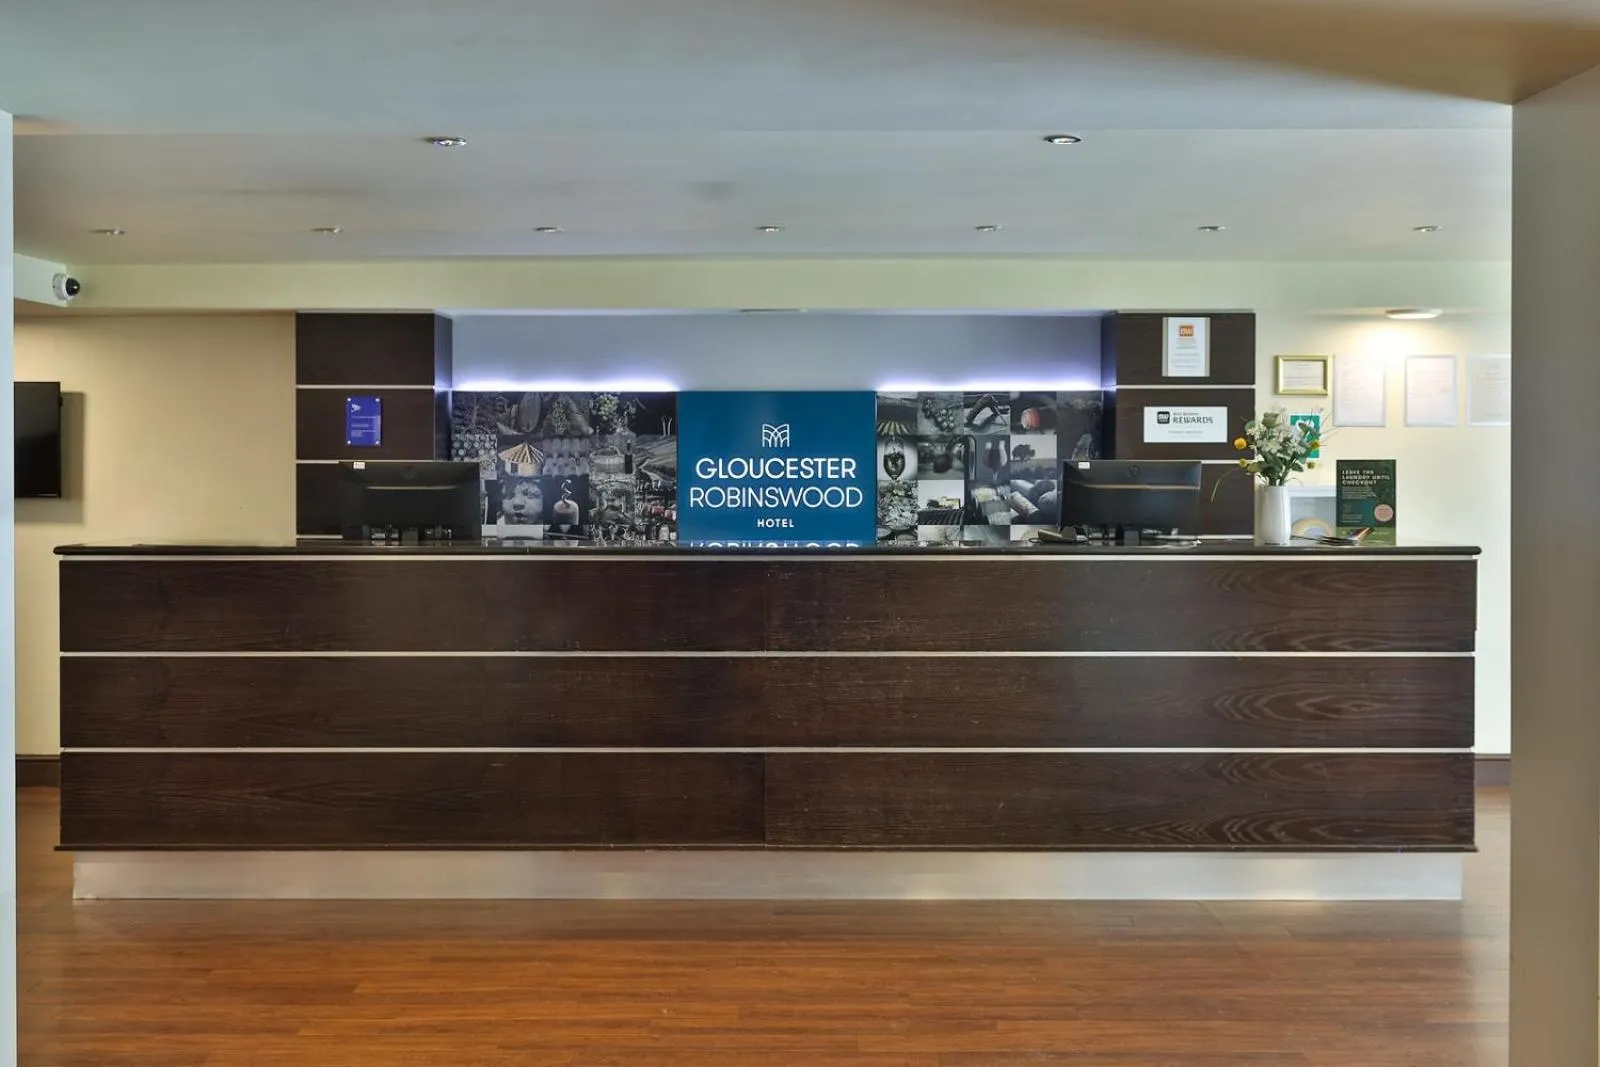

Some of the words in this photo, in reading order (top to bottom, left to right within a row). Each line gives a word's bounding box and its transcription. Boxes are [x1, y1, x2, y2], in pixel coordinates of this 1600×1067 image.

[1172, 416, 1214, 424] REWARDS
[695, 457, 857, 479] GLOUCESTER
[690, 486, 863, 508] ROBINSWOOD
[757, 518, 794, 528] HOTEL
